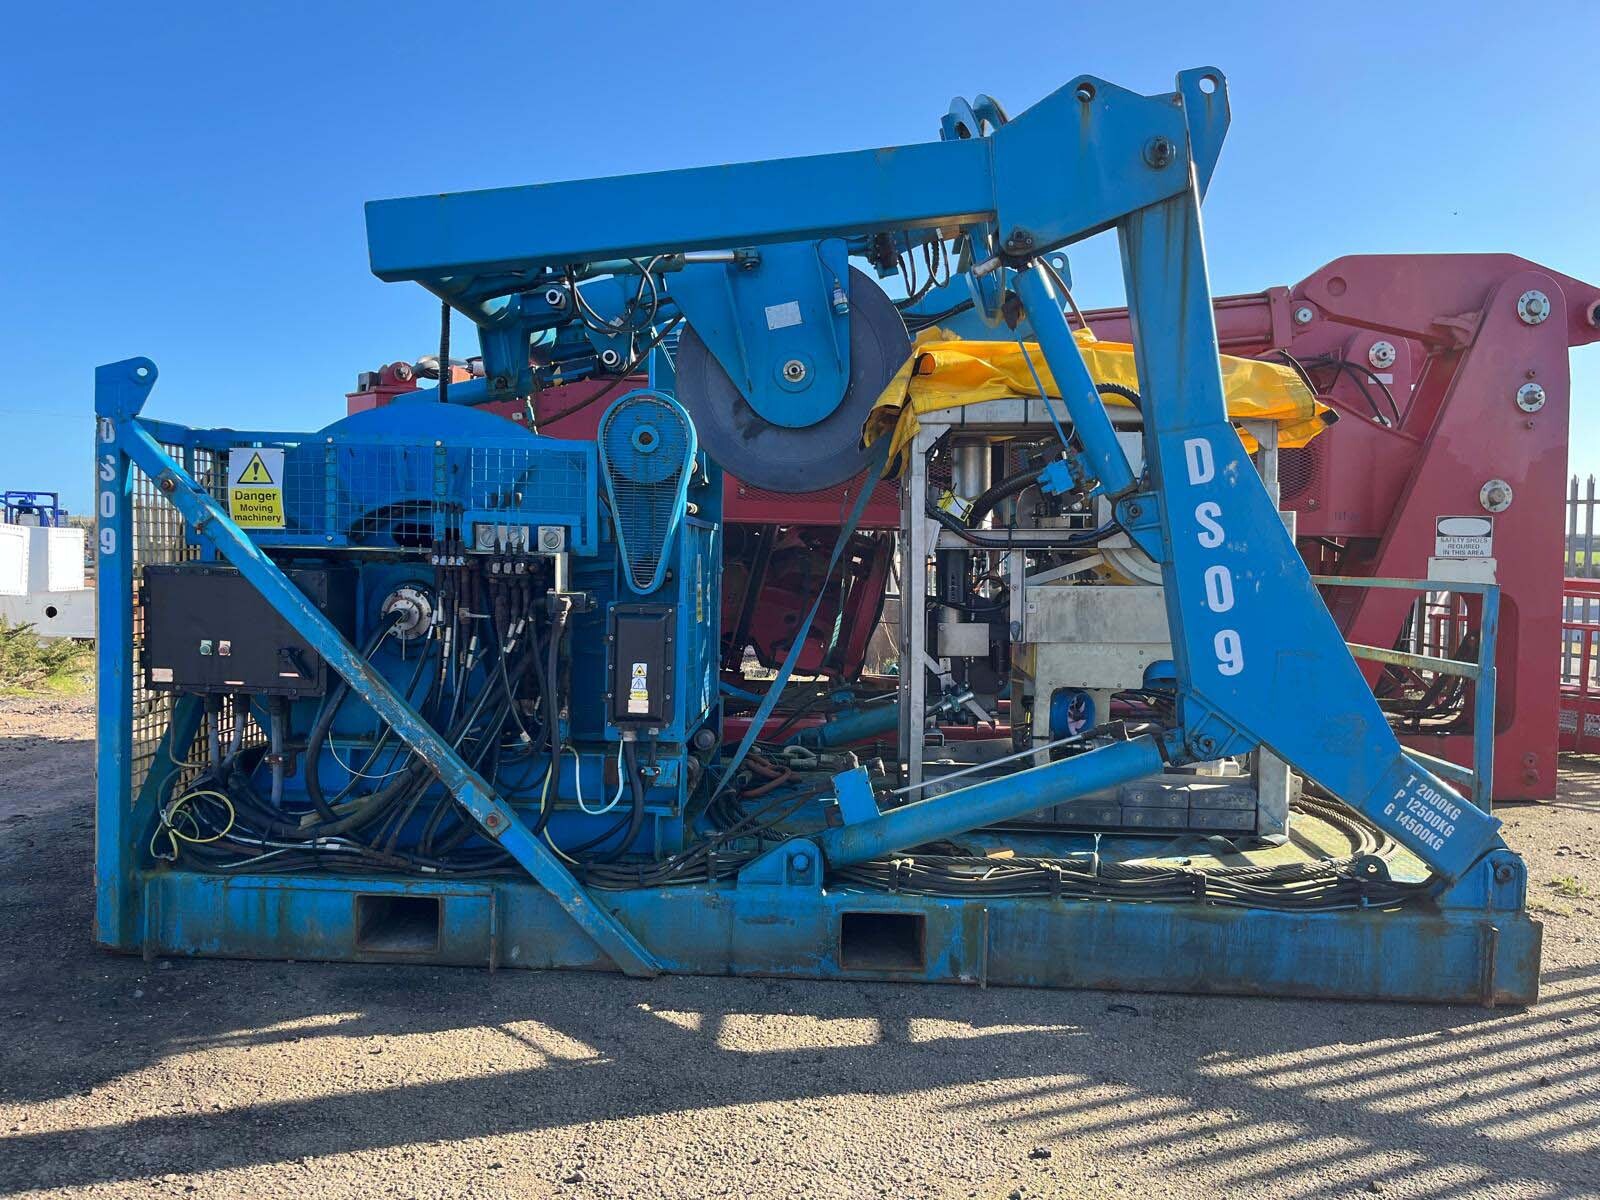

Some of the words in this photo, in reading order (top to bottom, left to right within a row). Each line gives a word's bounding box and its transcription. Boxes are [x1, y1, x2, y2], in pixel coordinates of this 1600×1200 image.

[235, 491, 277, 503] Danger
[240, 504, 273, 513] Moving
[234, 514, 281, 523] machinery
[1406, 775, 1417, 787] T
[1415, 783, 1462, 821] 2000KG
[1383, 802, 1396, 816] G
[1395, 811, 1444, 851] 14500KG
[1394, 789, 1406, 800] P
[1406, 797, 1455, 838] 12500KG
